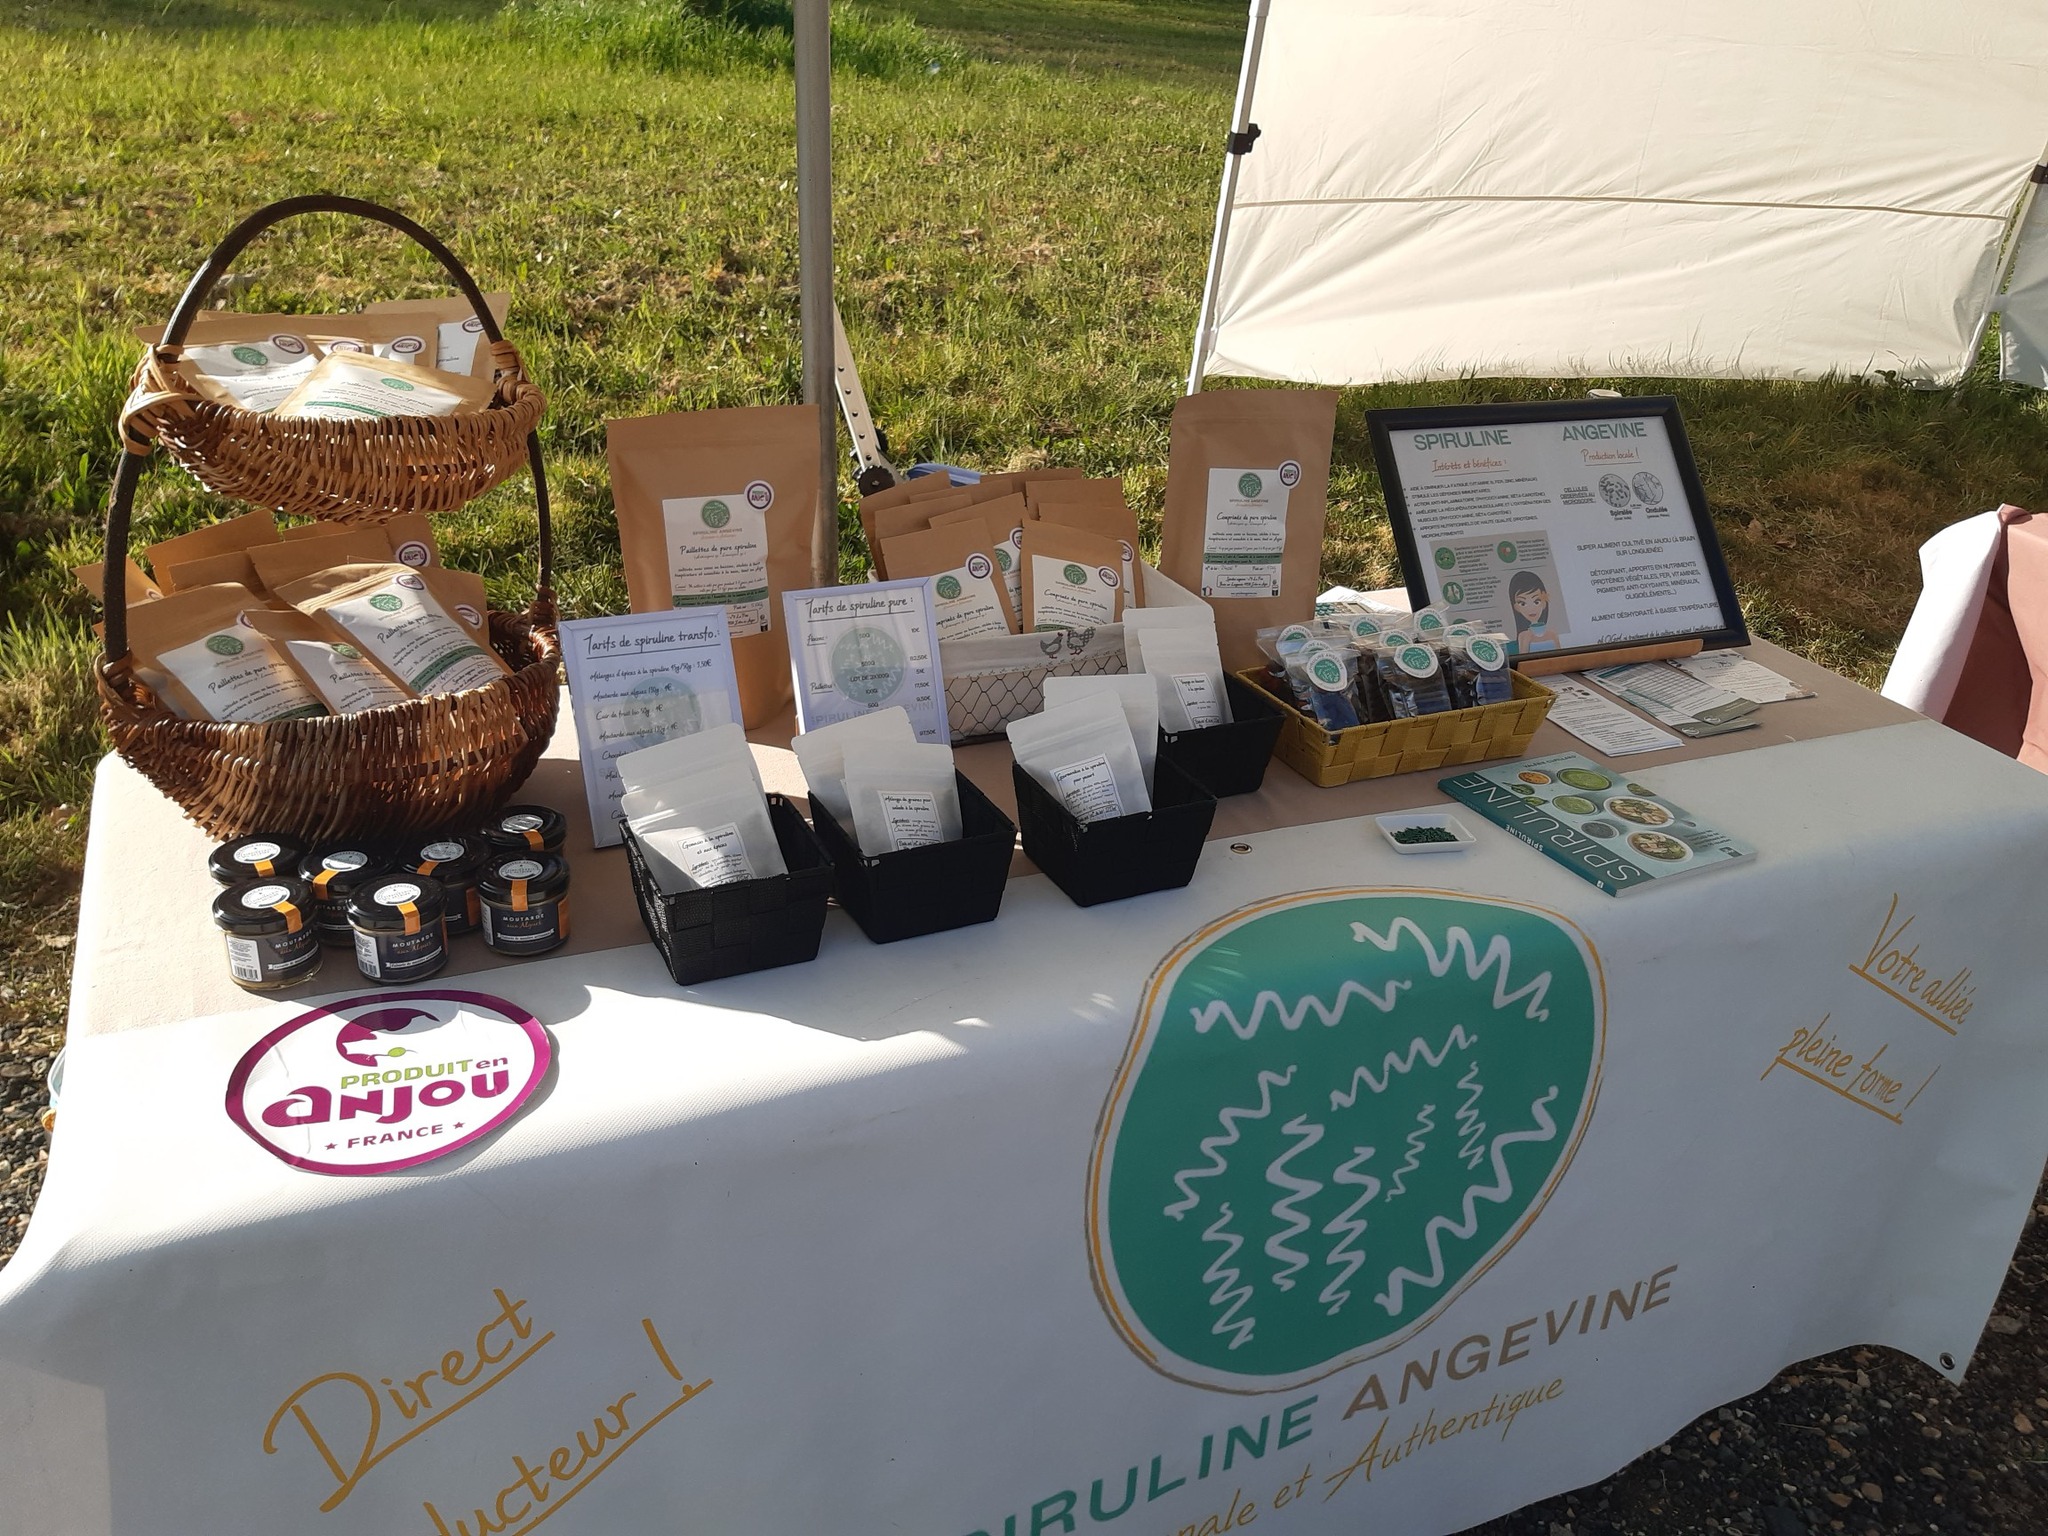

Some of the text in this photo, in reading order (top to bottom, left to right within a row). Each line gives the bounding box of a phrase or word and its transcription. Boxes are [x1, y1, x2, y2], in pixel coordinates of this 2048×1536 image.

[1413, 429, 1511, 450] SPIRULINE
[1563, 422, 1647, 441] ANGEVINE
[1464, 460, 1470, 468] et
[1581, 448, 1616, 462] Production
[1617, 450, 1634, 459] locale
[1217, 512, 1241, 523] Comprimés
[1261, 514, 1277, 523] spiruline
[680, 545, 710, 555] Paillettes
[720, 547, 732, 555] pure
[734, 542, 757, 553] spiruline
[1622, 538, 1644, 546] CULTIVÉ
[1628, 564, 1654, 572] APPORTS
[1663, 561, 1696, 570] NUTRIMENTS
[1044, 589, 1069, 600] Comprimés
[1090, 601, 1107, 610] spiruline
[1596, 584, 1625, 594] PIGMENTS
[805, 597, 908, 618] Tarifs de spiruline pure
[964, 611, 974, 619] pure
[975, 605, 994, 615] spiruline
[1591, 614, 1615, 622] ALIMENT
[1616, 609, 1653, 619] DÉSHYDRATÉ
[1678, 601, 1719, 612] TEMPÉRATURE
[377, 624, 407, 643] Paillettes
[415, 615, 426, 624] pure
[583, 633, 616, 655] Tarifs
[620, 636, 631, 647] de
[635, 631, 675, 653] spiruline
[208, 674, 243, 694] Paillettes
[254, 666, 267, 676] pure
[330, 672, 363, 683] Paillettes
[649, 666, 669, 675] spiruline
[715, 831, 734, 842] spiruline
[1453, 774, 1641, 881] SPIRULINE
[1505, 824, 1543, 852] SPIRULINE
[502, 913, 544, 922] MOUTARDE
[393, 932, 433, 948] MOUTARDE
[1861, 892, 1926, 994] Votre
[1760, 1013, 1853, 1082] pleine
[1844, 1043, 1903, 1103] forme
[341, 1056, 508, 1089] PRODUIT en
[347, 1124, 443, 1149] FRANCE
[1342, 1264, 1679, 1421] ANGEVINE
[263, 1288, 532, 1513] Direct
[1273, 1463, 1314, 1510] et
[1322, 1375, 1565, 1502] Authentique
